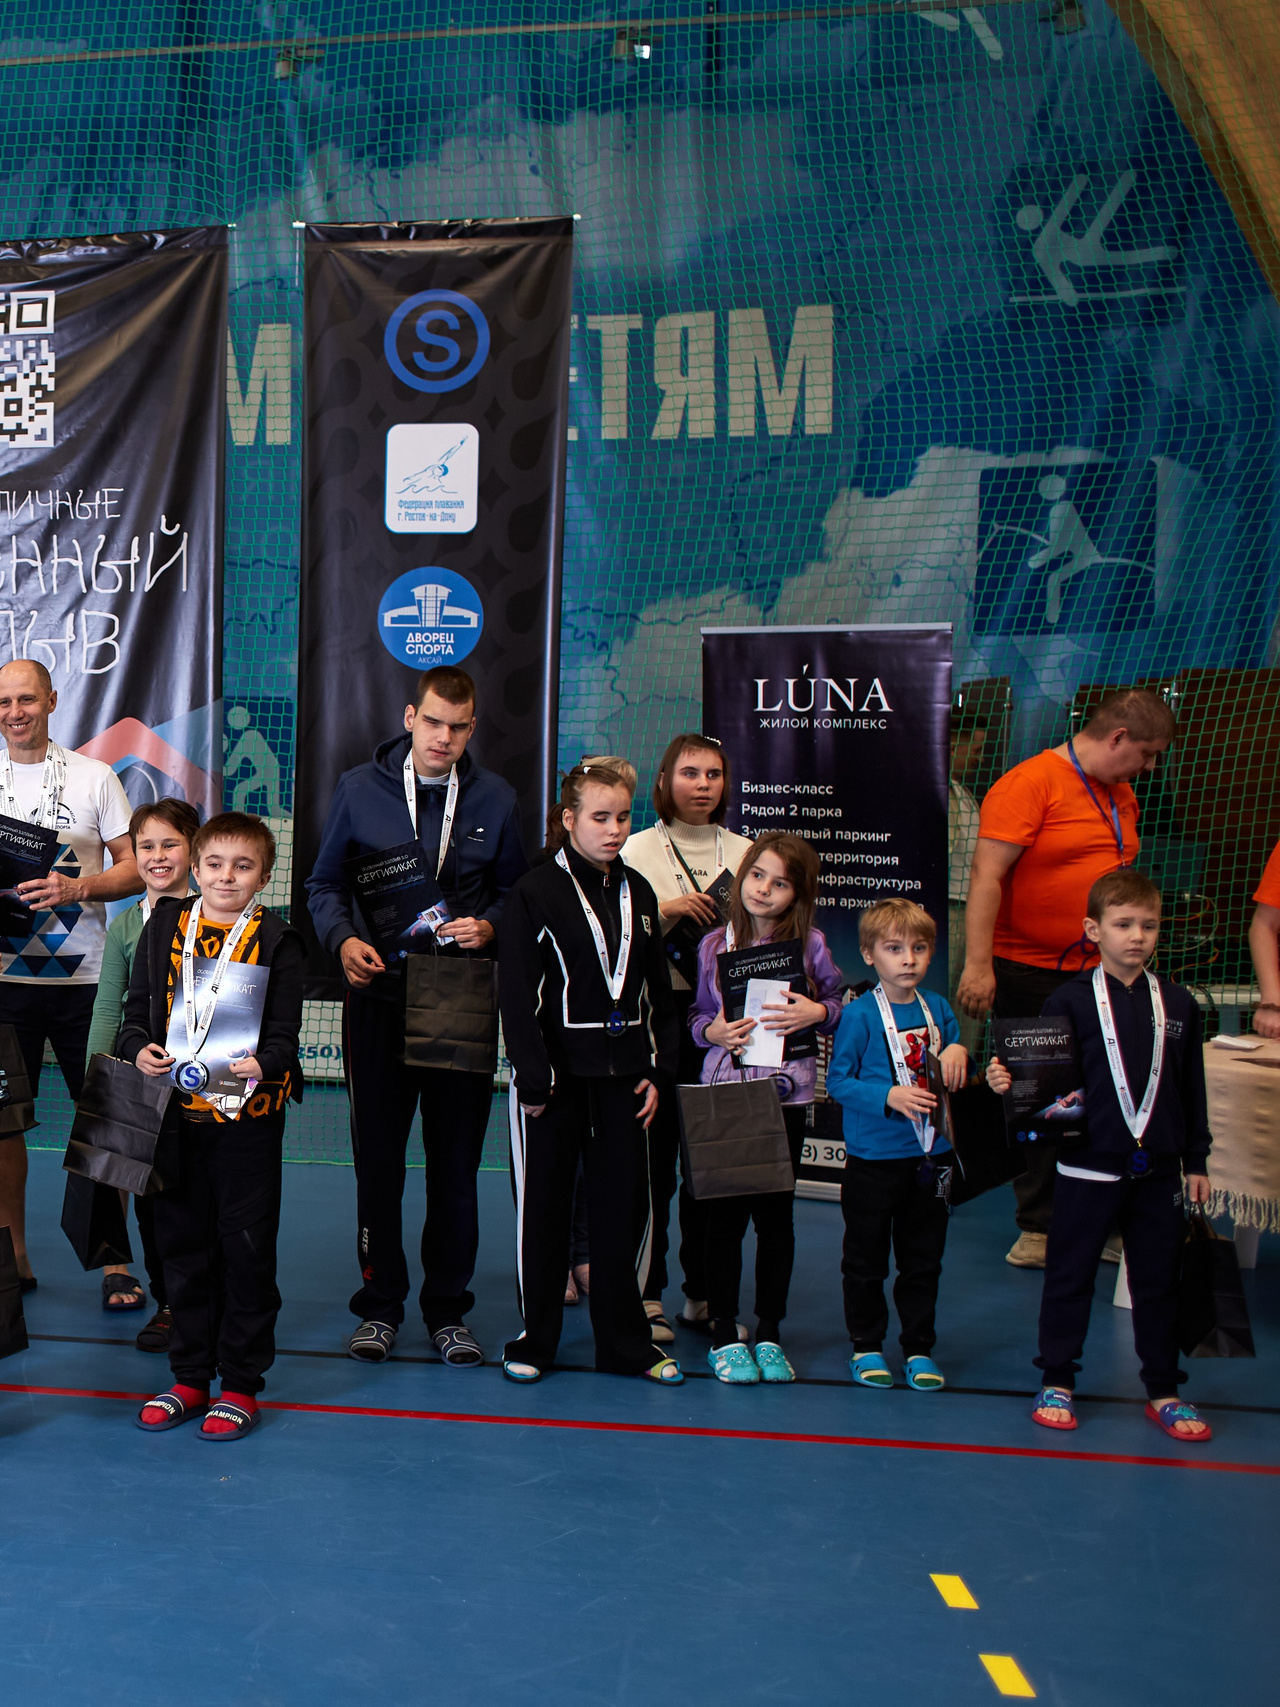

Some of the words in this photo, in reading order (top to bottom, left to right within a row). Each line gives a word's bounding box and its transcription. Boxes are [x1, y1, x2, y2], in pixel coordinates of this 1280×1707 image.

[406, 632, 455, 644] ДВОРЕЦ
[405, 643, 455, 655] СПОРТА
[759, 716, 809, 730] ЖИЛОЙ
[814, 718, 888, 730] КОМПЛЕКС
[741, 781, 834, 796] Бизнес-класс
[741, 804, 785, 818] Рядом
[789, 804, 798, 817] 2
[801, 807, 843, 819] парка
[835, 830, 891, 842] паркинг
[357, 857, 418, 884] СЕРТИФИКАТ
[728, 956, 793, 978] СЕРТИФИКАТ
[1004, 1034, 1070, 1048] СЕРТИФИКАТ
